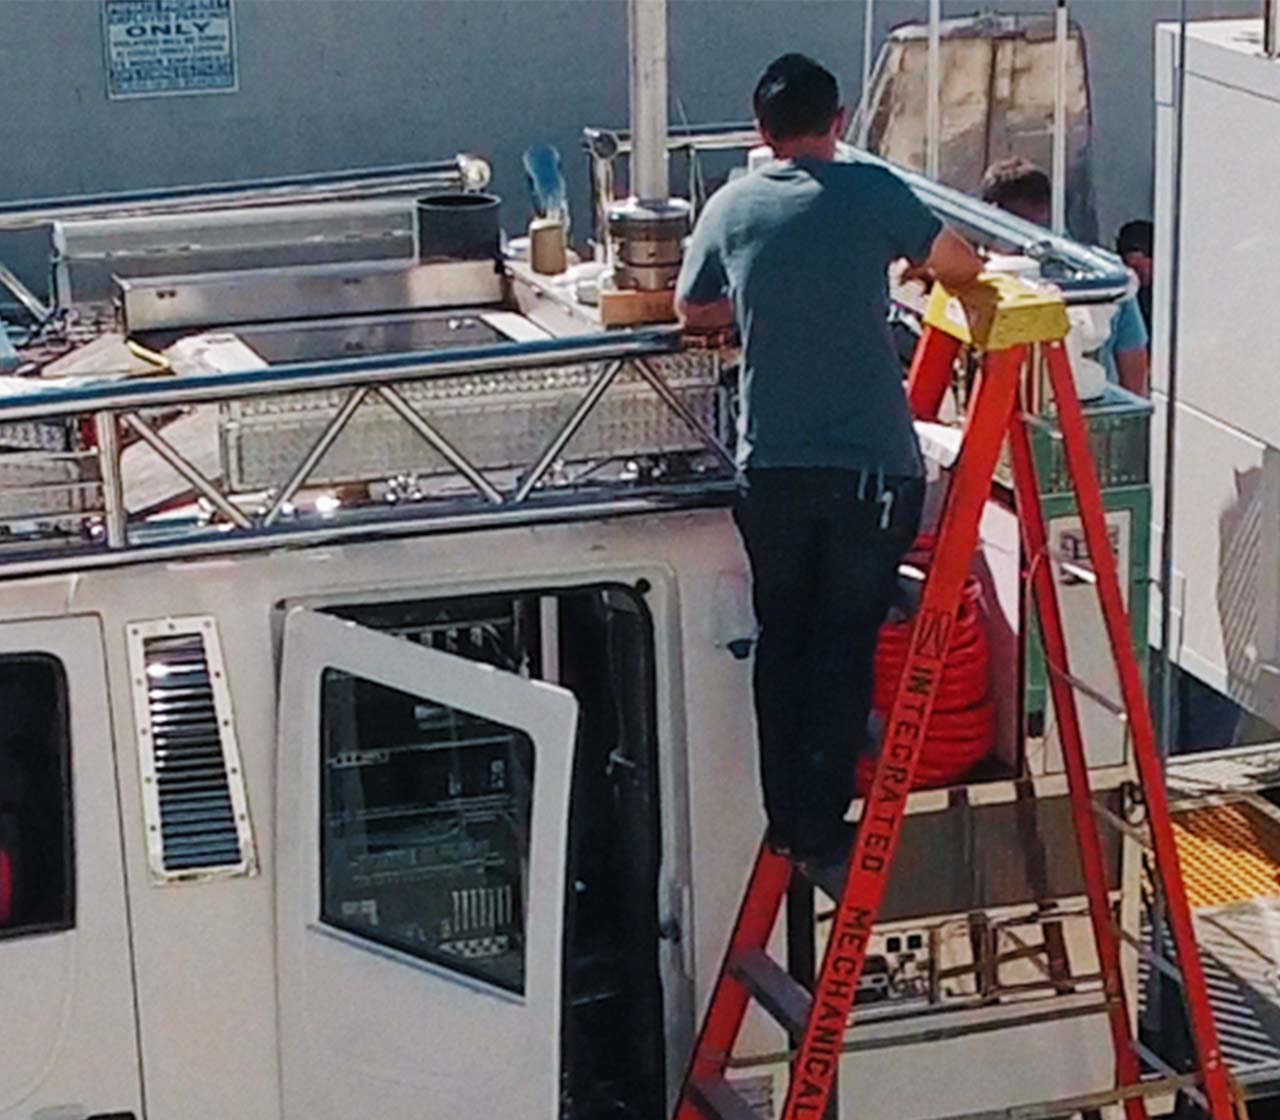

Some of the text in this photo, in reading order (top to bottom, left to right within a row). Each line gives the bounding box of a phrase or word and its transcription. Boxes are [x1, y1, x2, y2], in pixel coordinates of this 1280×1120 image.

[125, 21, 210, 38] ONLY
[860, 665, 935, 872] INTEGRATED
[790, 905, 870, 1120] MECHANICAL
